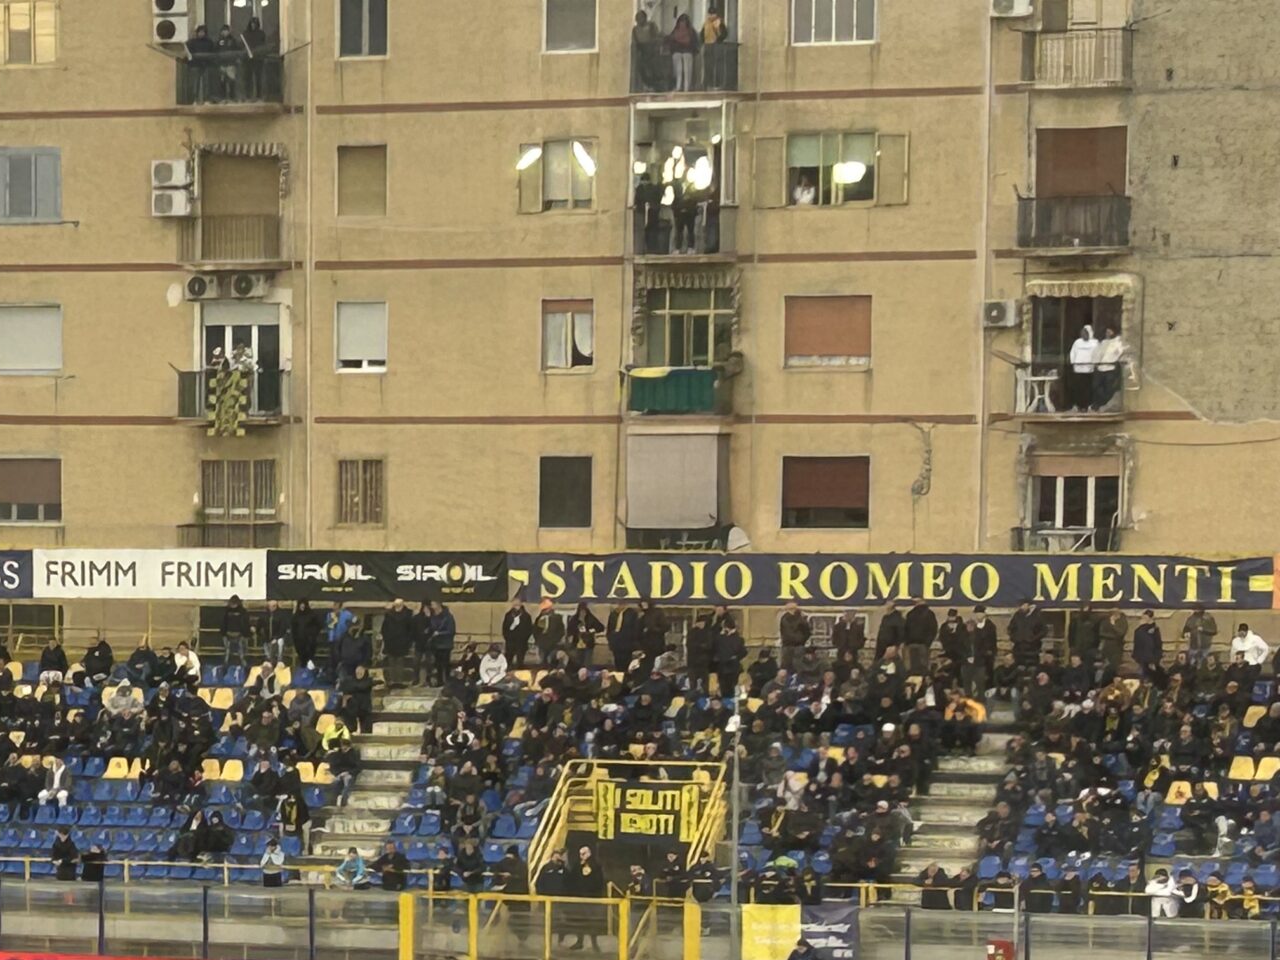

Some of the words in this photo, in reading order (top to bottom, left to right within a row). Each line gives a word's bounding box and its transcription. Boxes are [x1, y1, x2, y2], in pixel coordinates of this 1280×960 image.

[46, 561, 137, 586] FRIMM
[161, 561, 253, 587] FRIMM
[540, 560, 753, 599] STADIO
[777, 561, 1000, 601] ROMEO
[1033, 563, 1237, 602] MENTI
